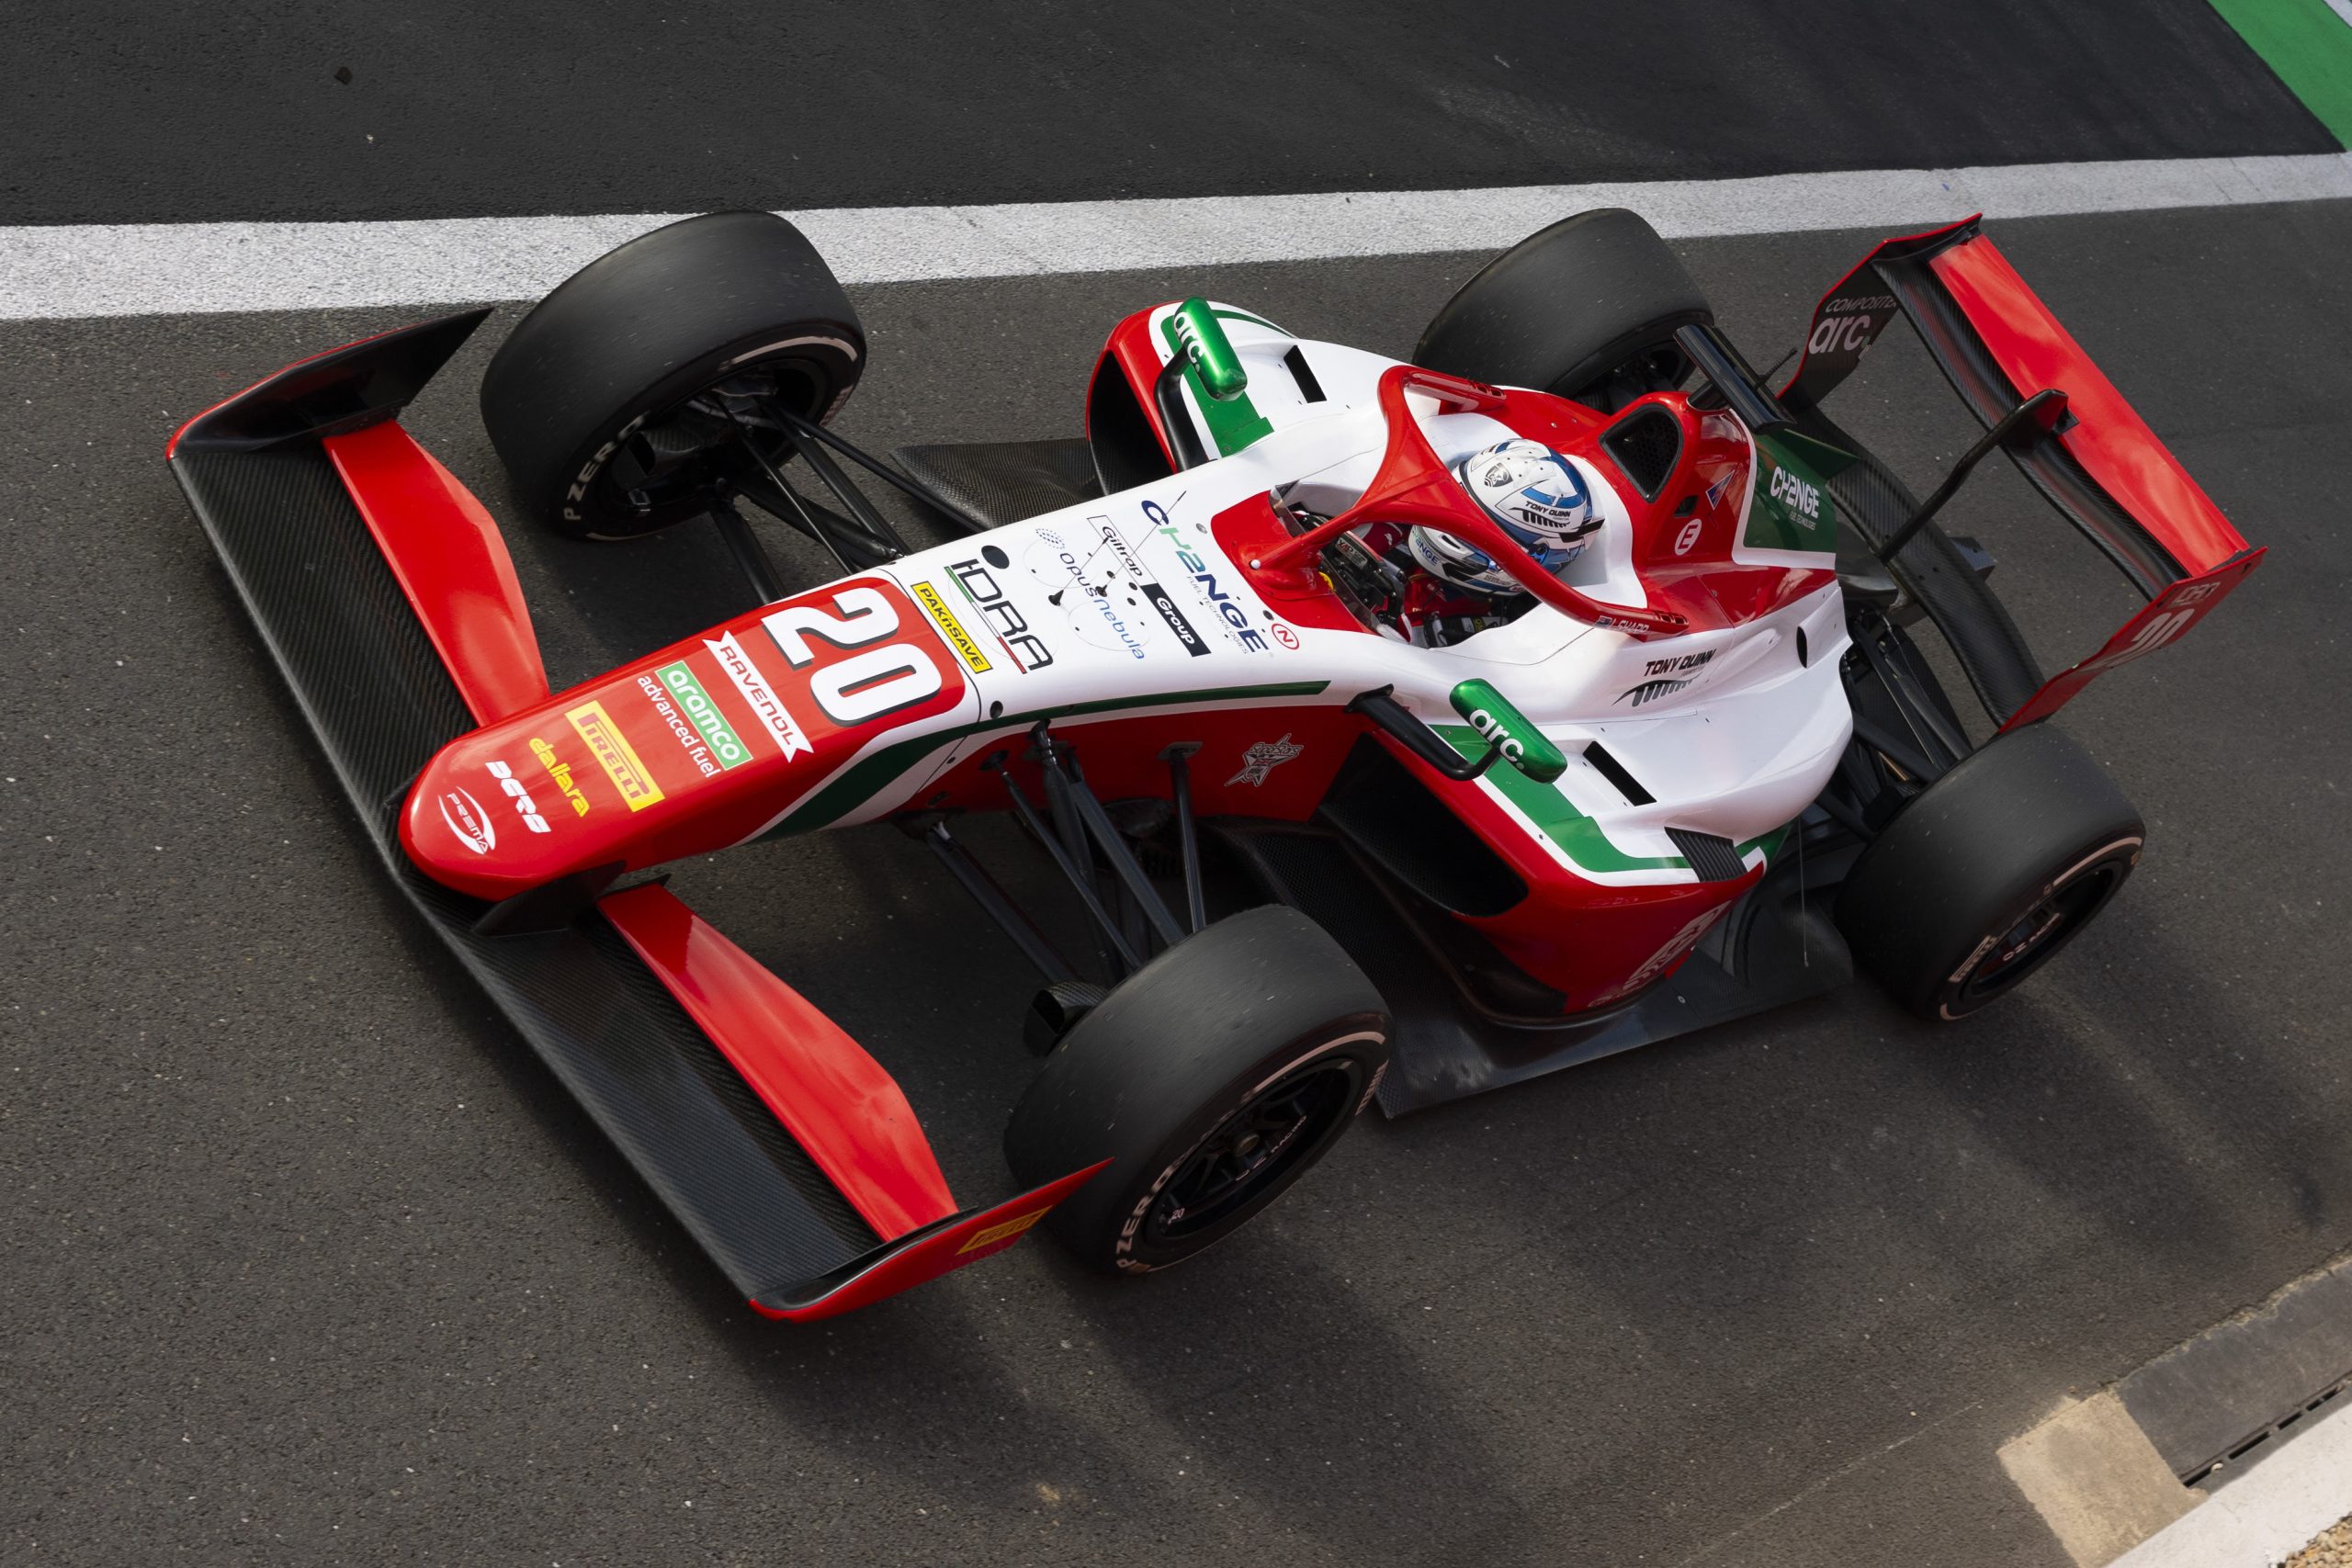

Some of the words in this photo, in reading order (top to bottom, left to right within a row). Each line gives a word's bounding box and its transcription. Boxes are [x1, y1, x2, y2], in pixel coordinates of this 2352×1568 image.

[1524, 501, 1549, 513] TONY
[1548, 509, 1571, 518] QUINN
[1102, 525, 1143, 577] Giltrap
[1157, 597, 1195, 645] Group
[719, 645, 797, 746] RAVENOL
[761, 587, 943, 725] 20
[1644, 656, 1682, 677] TONY
[1679, 649, 1717, 671] QUINN
[576, 712, 650, 799] PIRELLI
[637, 675, 697, 748] advanced
[689, 746, 722, 778] fuel
[667, 670, 741, 761] aramco
[528, 738, 591, 818] dallara
